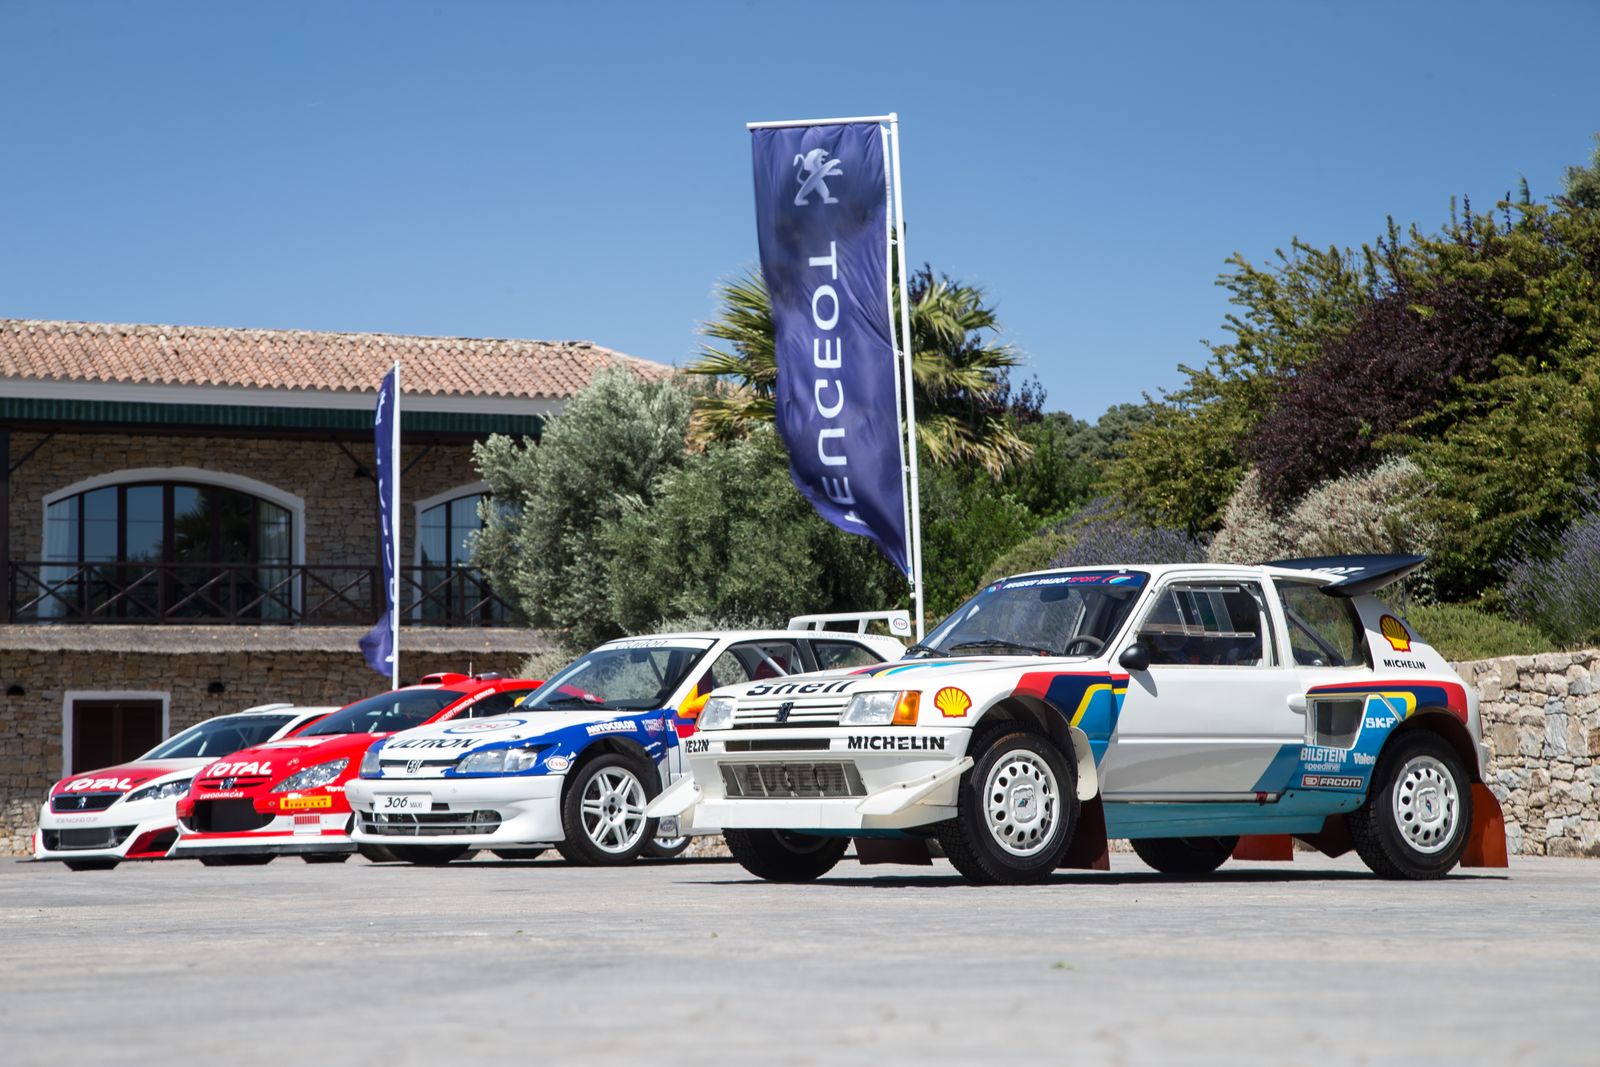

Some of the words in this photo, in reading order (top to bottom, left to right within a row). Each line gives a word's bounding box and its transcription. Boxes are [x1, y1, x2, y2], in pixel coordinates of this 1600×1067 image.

[1383, 659, 1426, 669] MICHELIN
[746, 680, 857, 696] Shell
[586, 720, 637, 734] AUTOCOLOR
[1365, 717, 1396, 728] SKF
[388, 738, 482, 749] ULTRON
[848, 736, 944, 750] MICHELIN
[1300, 748, 1347, 763] BILSTEIN
[1353, 753, 1376, 765] Valeo
[206, 761, 272, 776] TOTAL
[64, 778, 132, 792] TOTAL
[1320, 777, 1361, 787] FACOM
[384, 796, 408, 808] 306
